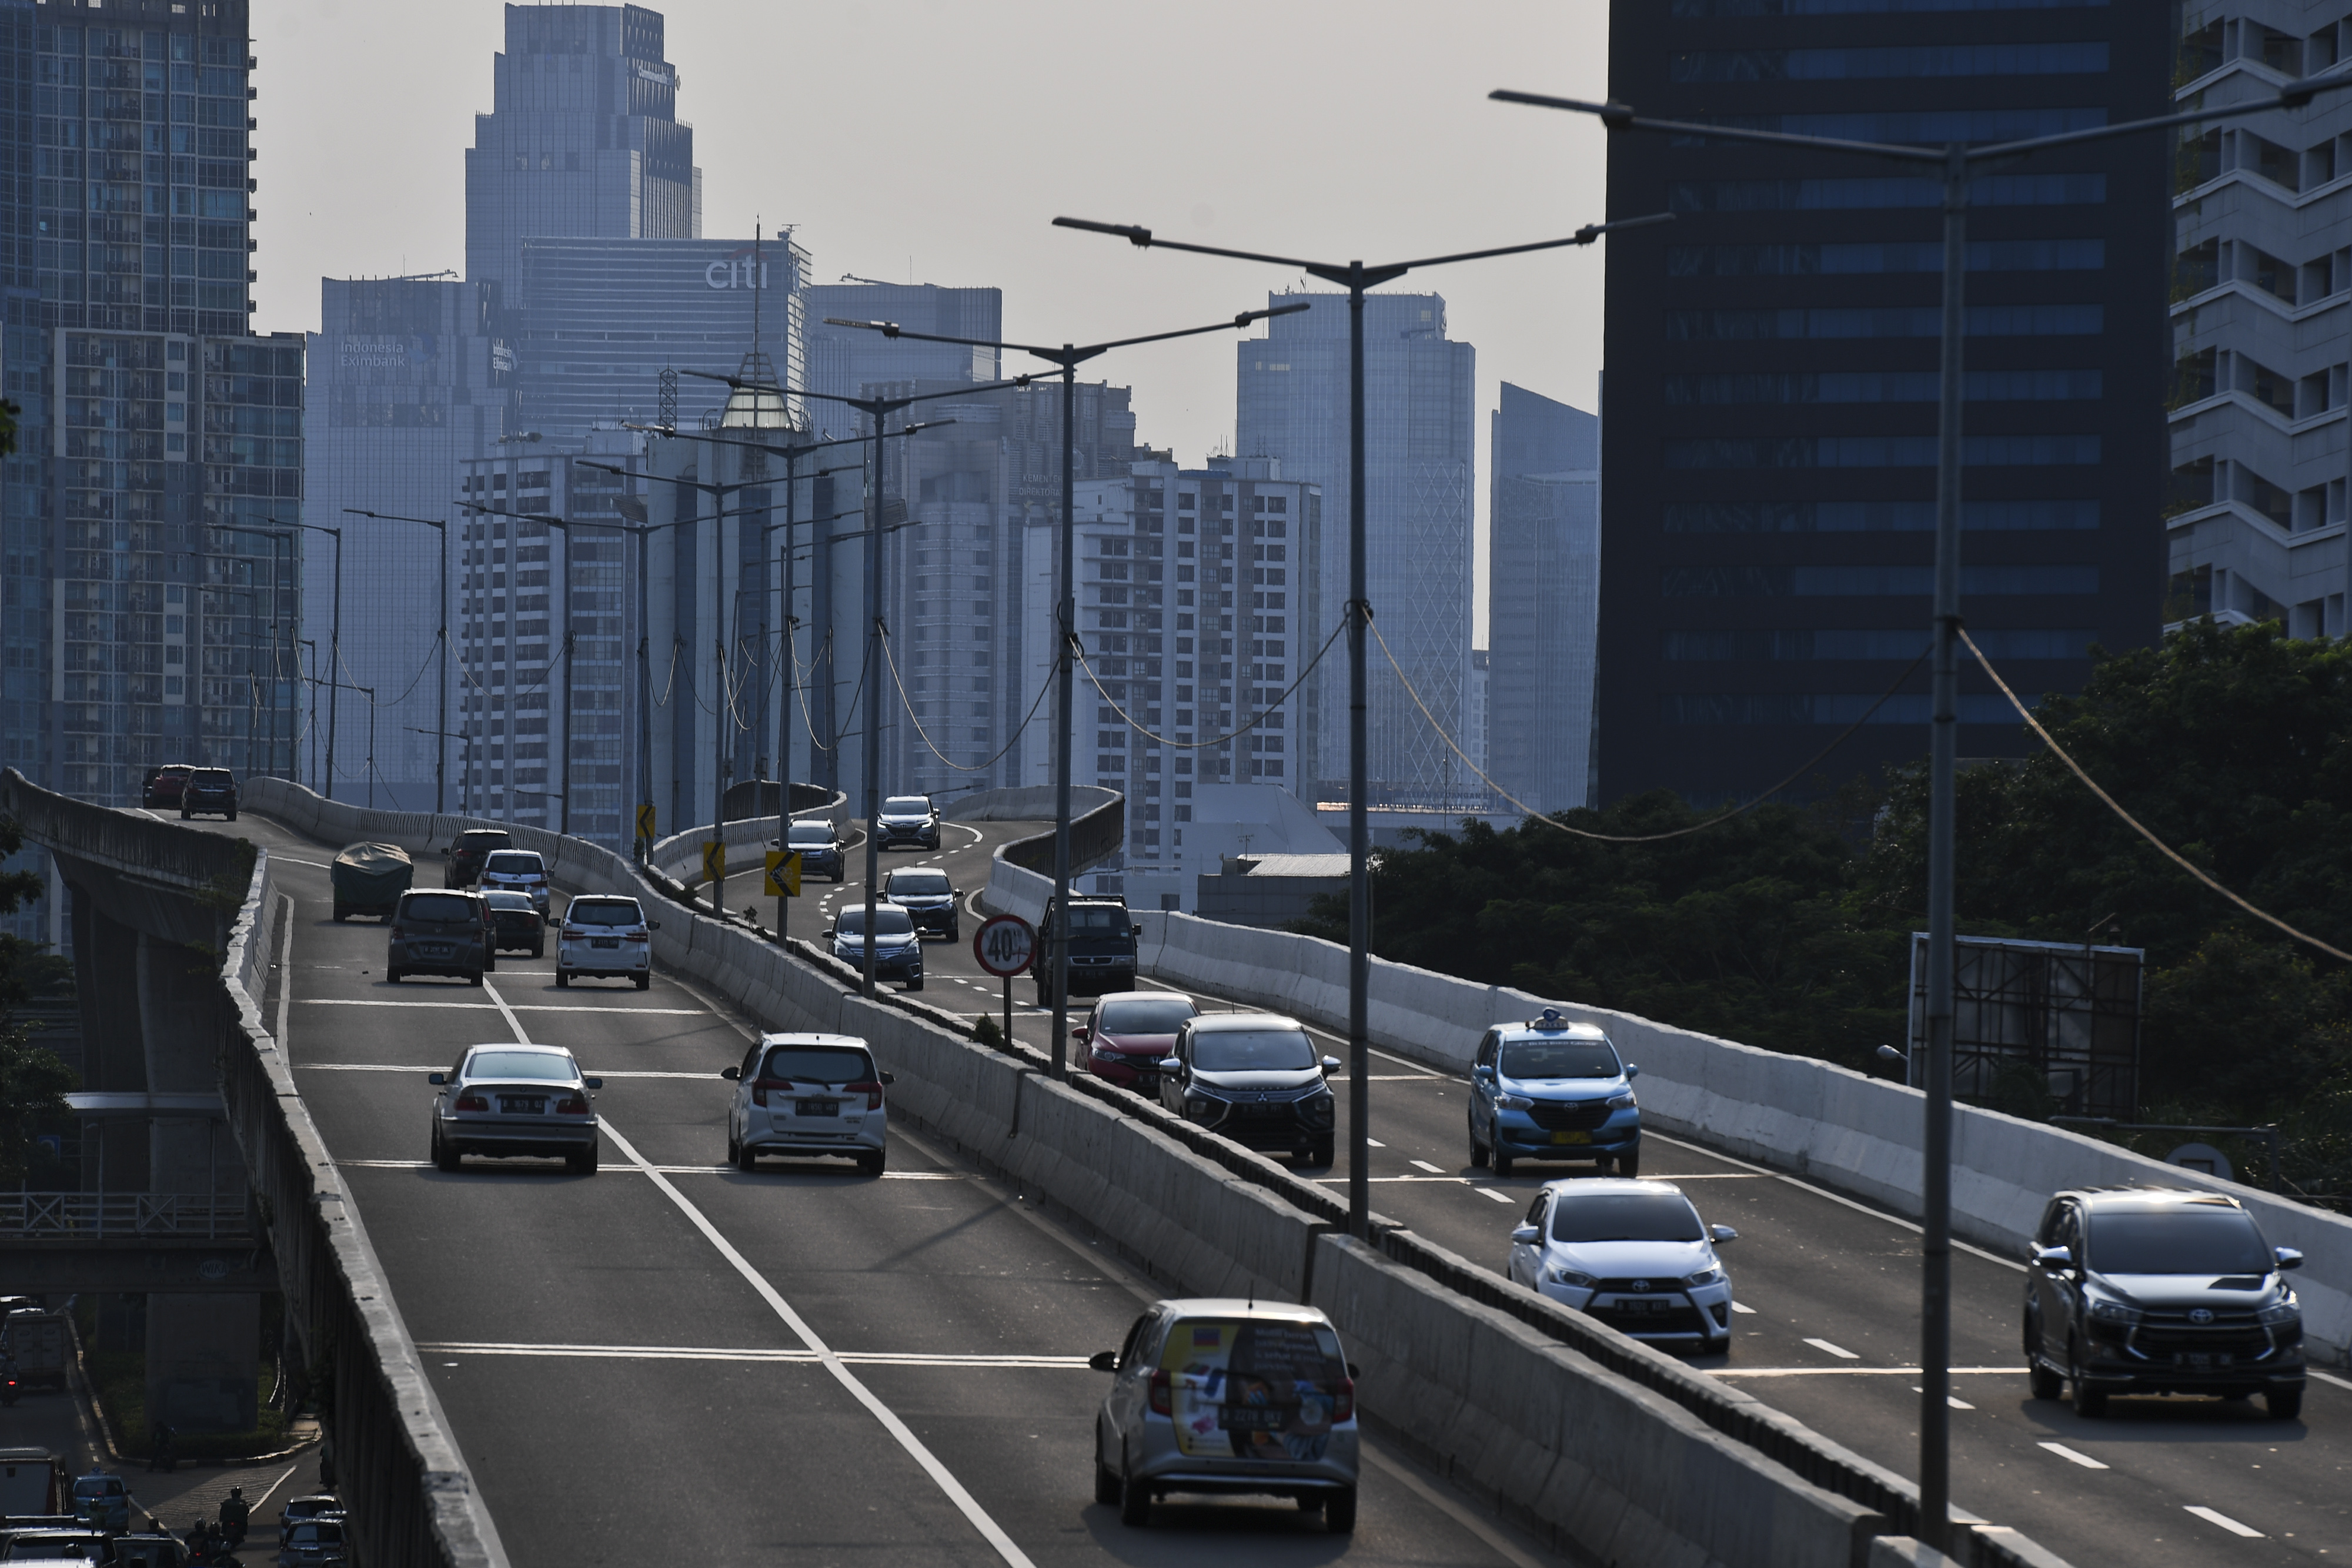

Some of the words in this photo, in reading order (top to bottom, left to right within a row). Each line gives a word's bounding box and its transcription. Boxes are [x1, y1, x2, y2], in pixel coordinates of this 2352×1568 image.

[706, 255, 767, 289] citi
[341, 341, 404, 353] Indonesia
[341, 355, 405, 366] Eximbank
[1019, 487, 1063, 496] DIREKTORA
[988, 928, 1013, 962] 40
[202, 1263, 227, 1273] WIKA
